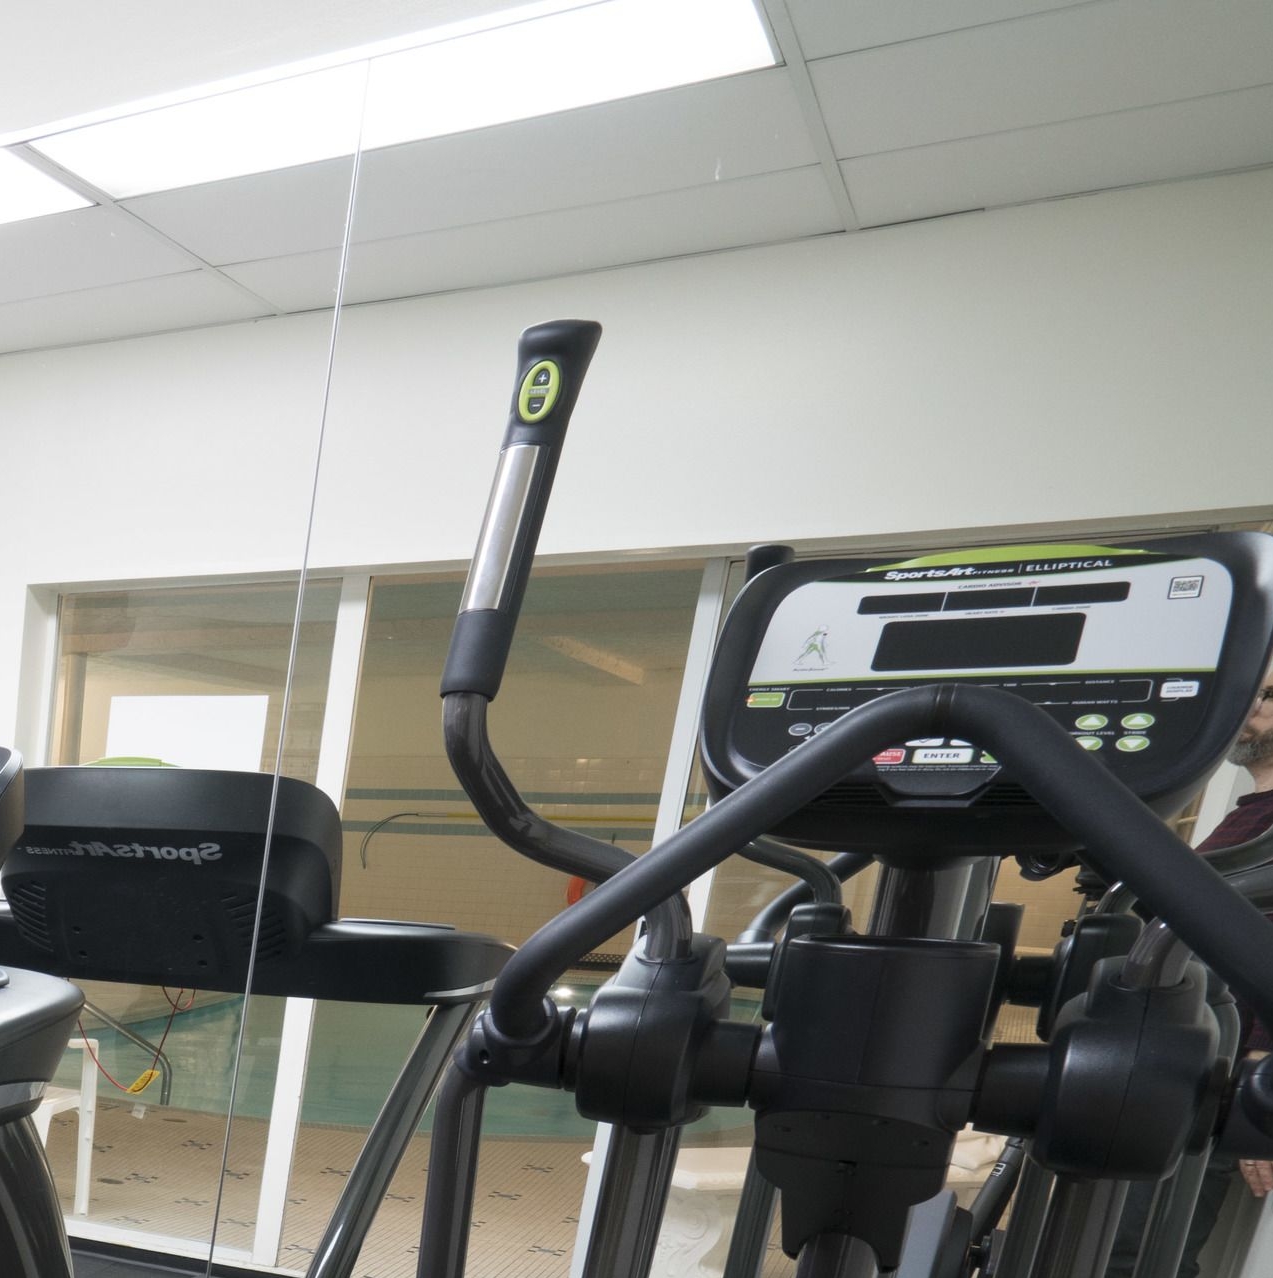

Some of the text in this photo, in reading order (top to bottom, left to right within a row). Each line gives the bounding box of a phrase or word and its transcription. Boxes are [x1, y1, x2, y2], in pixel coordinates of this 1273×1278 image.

[884, 565, 975, 581] SportsArt
[1025, 559, 1114, 573] ELLIPTICAL
[924, 752, 960, 760] ENTER
